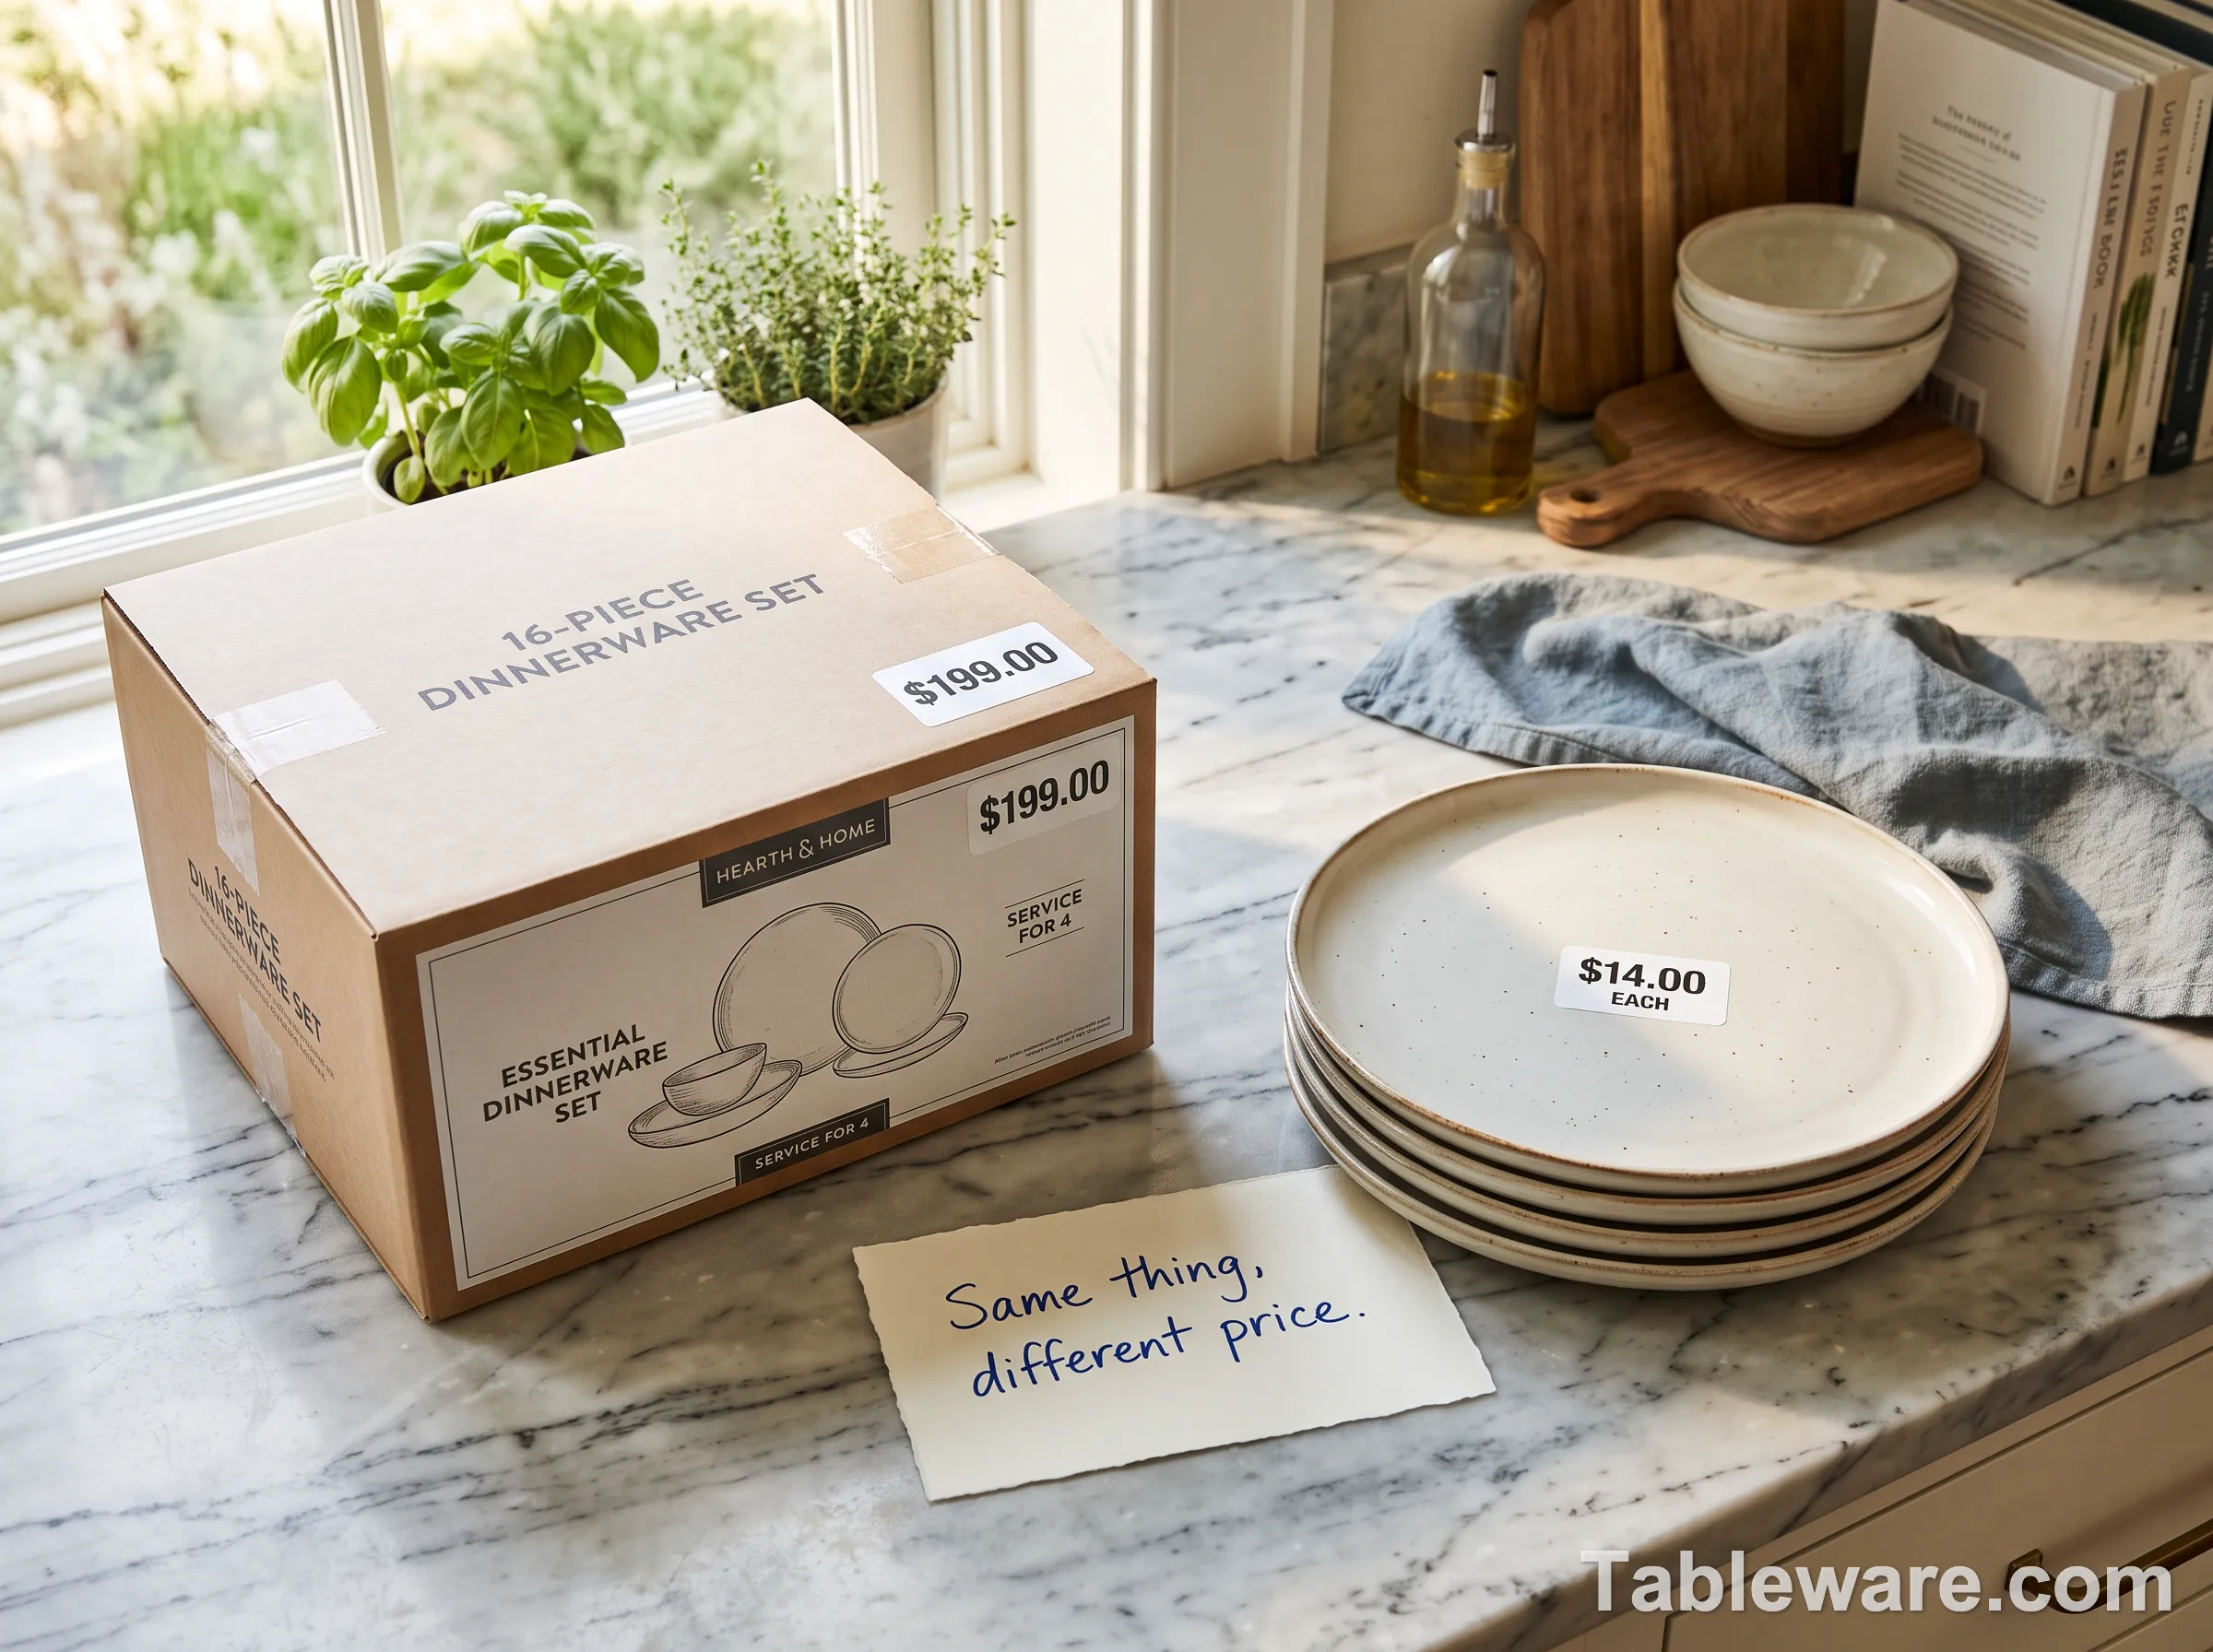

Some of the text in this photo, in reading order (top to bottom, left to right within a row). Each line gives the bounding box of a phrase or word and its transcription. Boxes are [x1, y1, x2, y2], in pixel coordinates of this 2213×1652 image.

[418, 573, 824, 711] DINNERWARE SET
[502, 579, 704, 651] 16-PIECE
[904, 642, 1059, 705] $199.00
[980, 760, 1109, 834] $199.00
[716, 818, 875, 884] HEARTH & HOME
[214, 866, 281, 964] 16-PIECE
[1007, 888, 1083, 928] SERVICE
[1019, 913, 1071, 943] FOR 4
[187, 857, 290, 1005] DINNERWARE
[292, 990, 322, 1043] SET
[1579, 957, 1706, 995] $14.00
[1611, 991, 1670, 1011] EACH
[482, 1041, 669, 1123] DINNERWARE
[501, 1023, 645, 1089] ESSENTIAL
[554, 1091, 602, 1124] SET
[754, 1117, 870, 1170] SERVICE FOR 4
[945, 1255, 1264, 1329] Same thing,
[972, 1300, 1367, 1398] different price.
